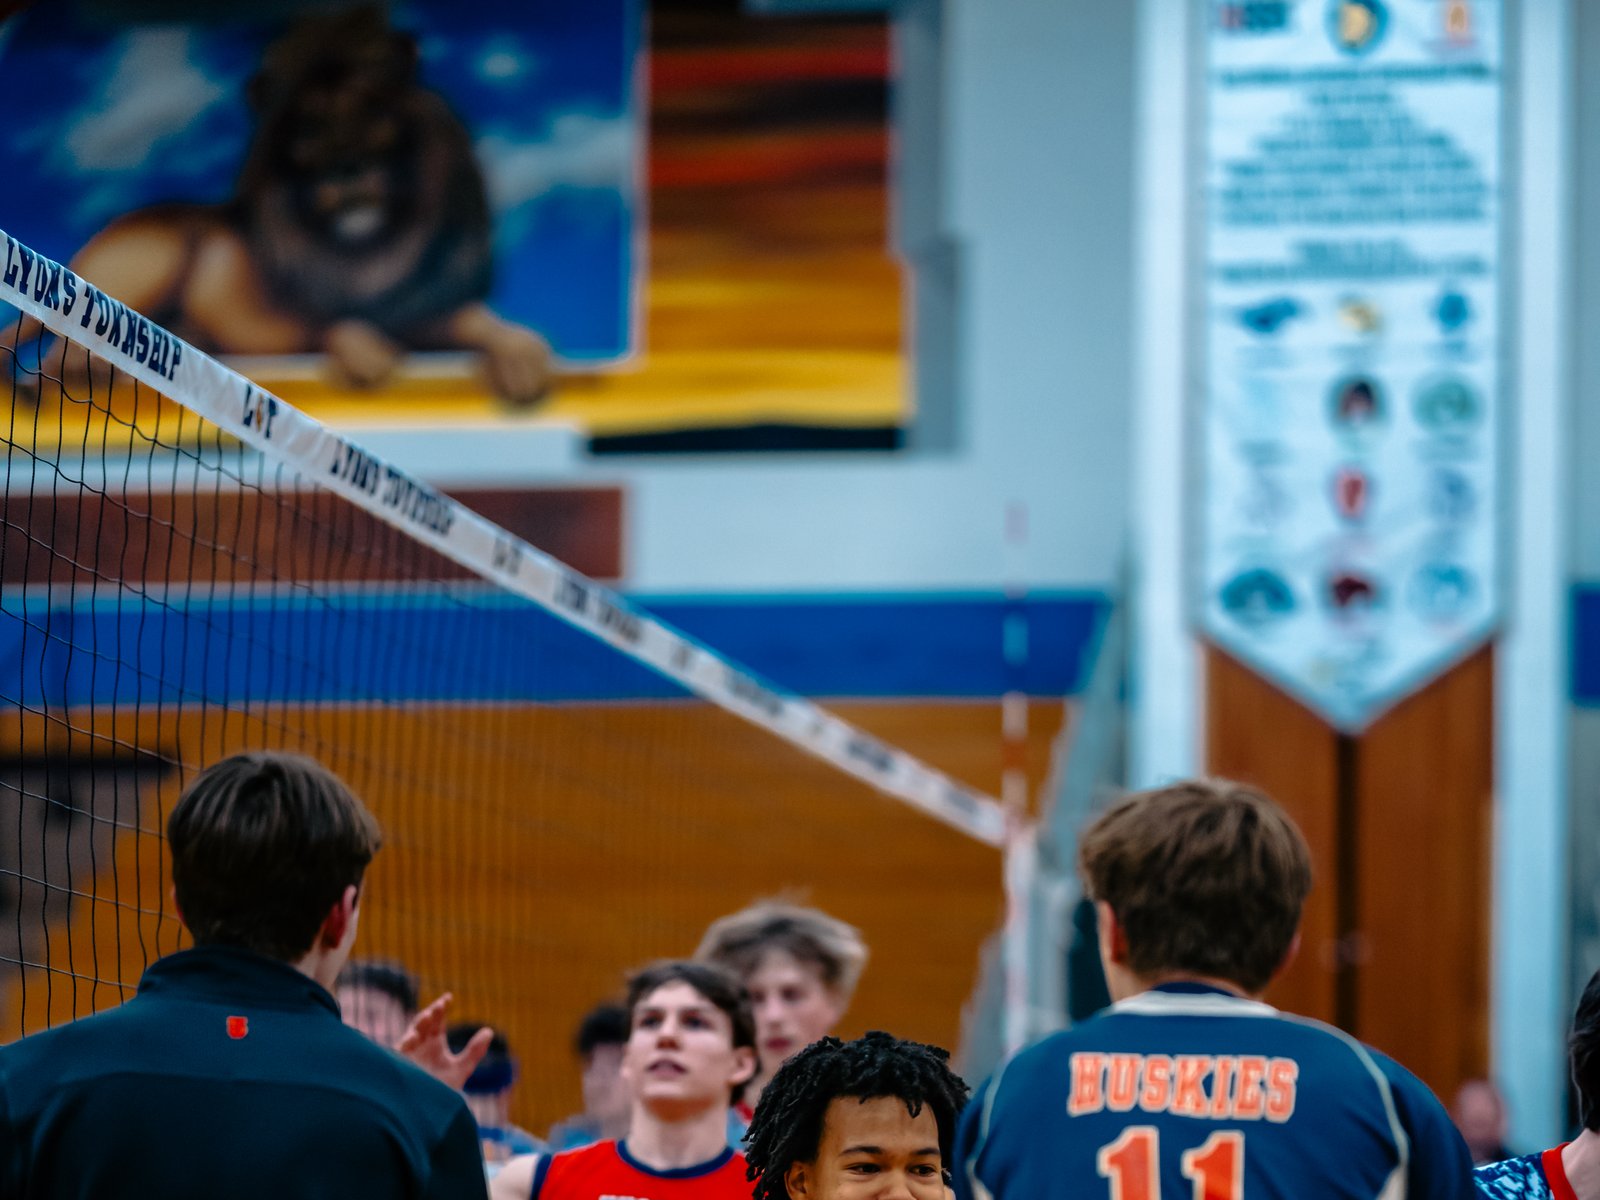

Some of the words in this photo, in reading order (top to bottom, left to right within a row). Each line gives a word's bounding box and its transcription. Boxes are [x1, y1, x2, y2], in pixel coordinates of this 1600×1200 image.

[3, 236, 77, 316] LYONS
[80, 282, 183, 381] TOWNSHIP
[1067, 1051, 1298, 1123] HUSKIES
